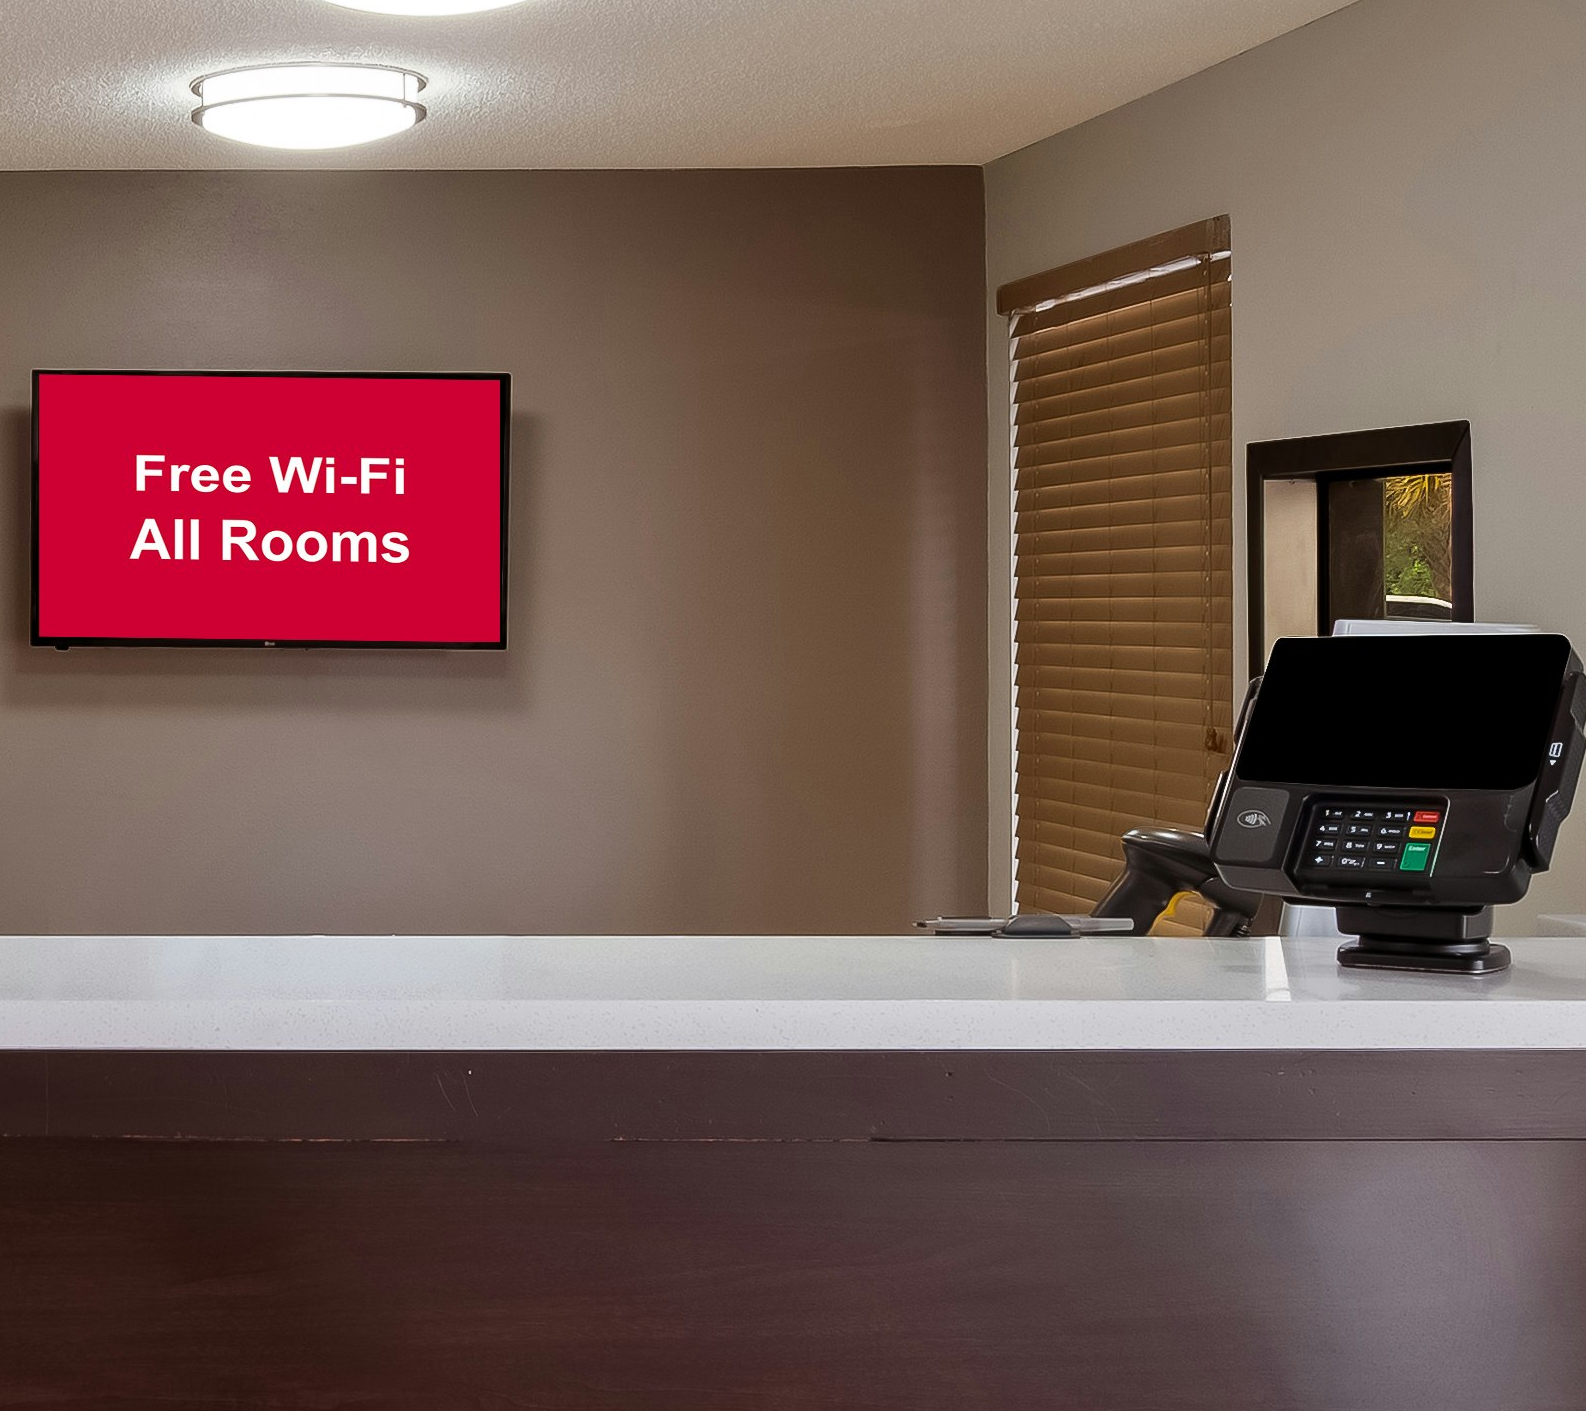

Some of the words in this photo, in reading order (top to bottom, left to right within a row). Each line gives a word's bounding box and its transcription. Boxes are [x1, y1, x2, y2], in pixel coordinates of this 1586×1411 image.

[136, 455, 251, 493] Free
[269, 457, 405, 495] Wi-Fi
[130, 519, 200, 560] All
[222, 520, 410, 563] Rooms
